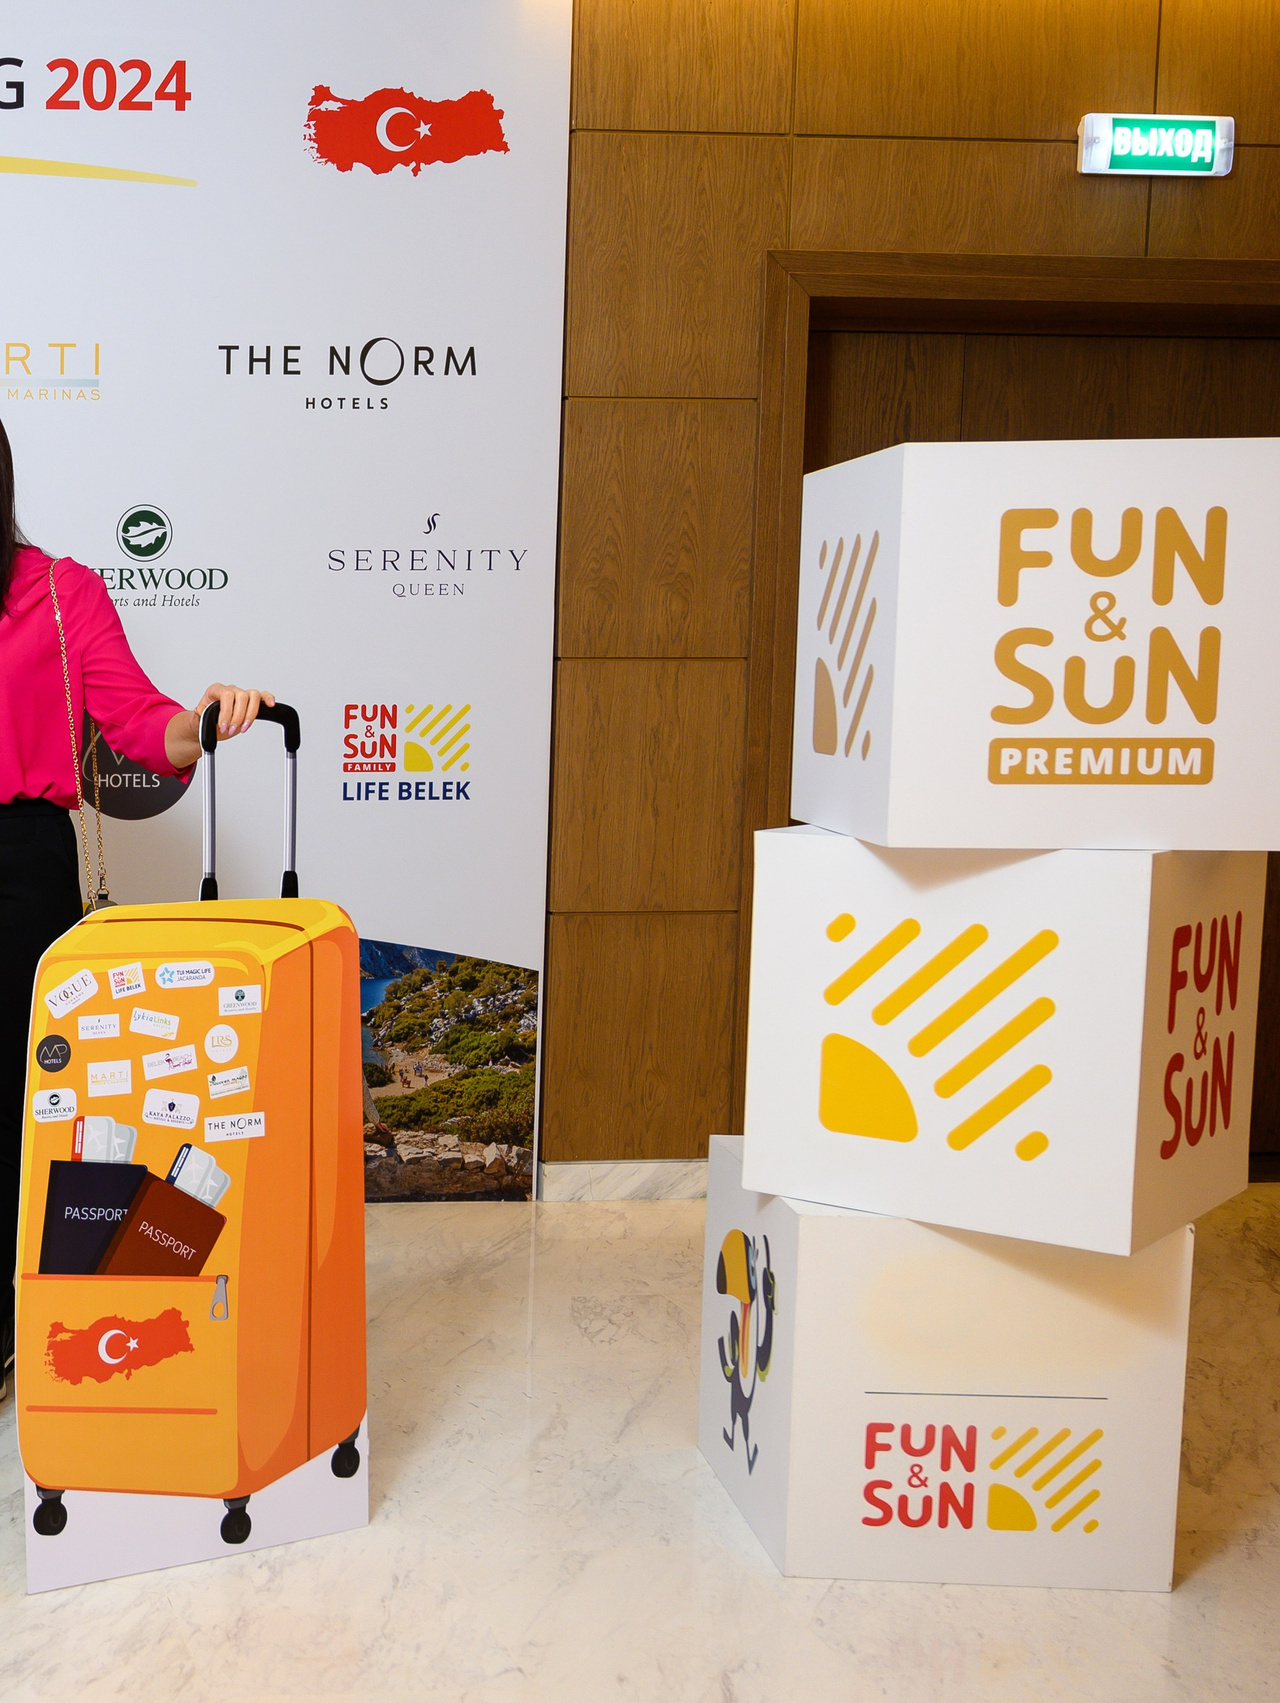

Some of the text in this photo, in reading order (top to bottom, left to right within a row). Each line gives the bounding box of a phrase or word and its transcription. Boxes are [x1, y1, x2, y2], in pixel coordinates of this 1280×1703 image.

[45, 57, 192, 112] 2024
[1113, 127, 1212, 162] ВЫХОД
[218, 337, 477, 386] THE NORM
[8, 389, 101, 400] MARINAS
[306, 398, 388, 410] HOTELS
[328, 550, 528, 571] SERENITY
[997, 506, 1227, 607] FUN
[90, 568, 228, 590] ERWOOD
[393, 583, 464, 598] QUEEN
[134, 594, 157, 607] and
[162, 595, 200, 607] Hotels
[1084, 591, 1127, 642] &
[990, 626, 1221, 725] SUN
[344, 704, 397, 729] FUN
[365, 725, 375, 738] &
[343, 734, 397, 758] SUN
[1000, 747, 1202, 775] PREMIUM
[98, 774, 160, 788] HOTELS
[343, 781, 470, 801] LIFE BELEK
[112, 971, 124, 979] FUN
[1167, 911, 1242, 1034] FUN
[49, 974, 91, 1007] VOGUE
[1194, 1006, 1207, 1060] &
[91, 1071, 128, 1080] MARTI
[1160, 1031, 1234, 1160] SUN
[35, 1107, 74, 1115] SHERWOOD
[165, 1113, 191, 1121] PALAZZO
[208, 1118, 261, 1130] THE NORM
[138, 1221, 196, 1261] PASSPORT
[864, 1422, 977, 1473] FUN
[907, 1463, 928, 1488] &
[861, 1479, 974, 1530] SUN
